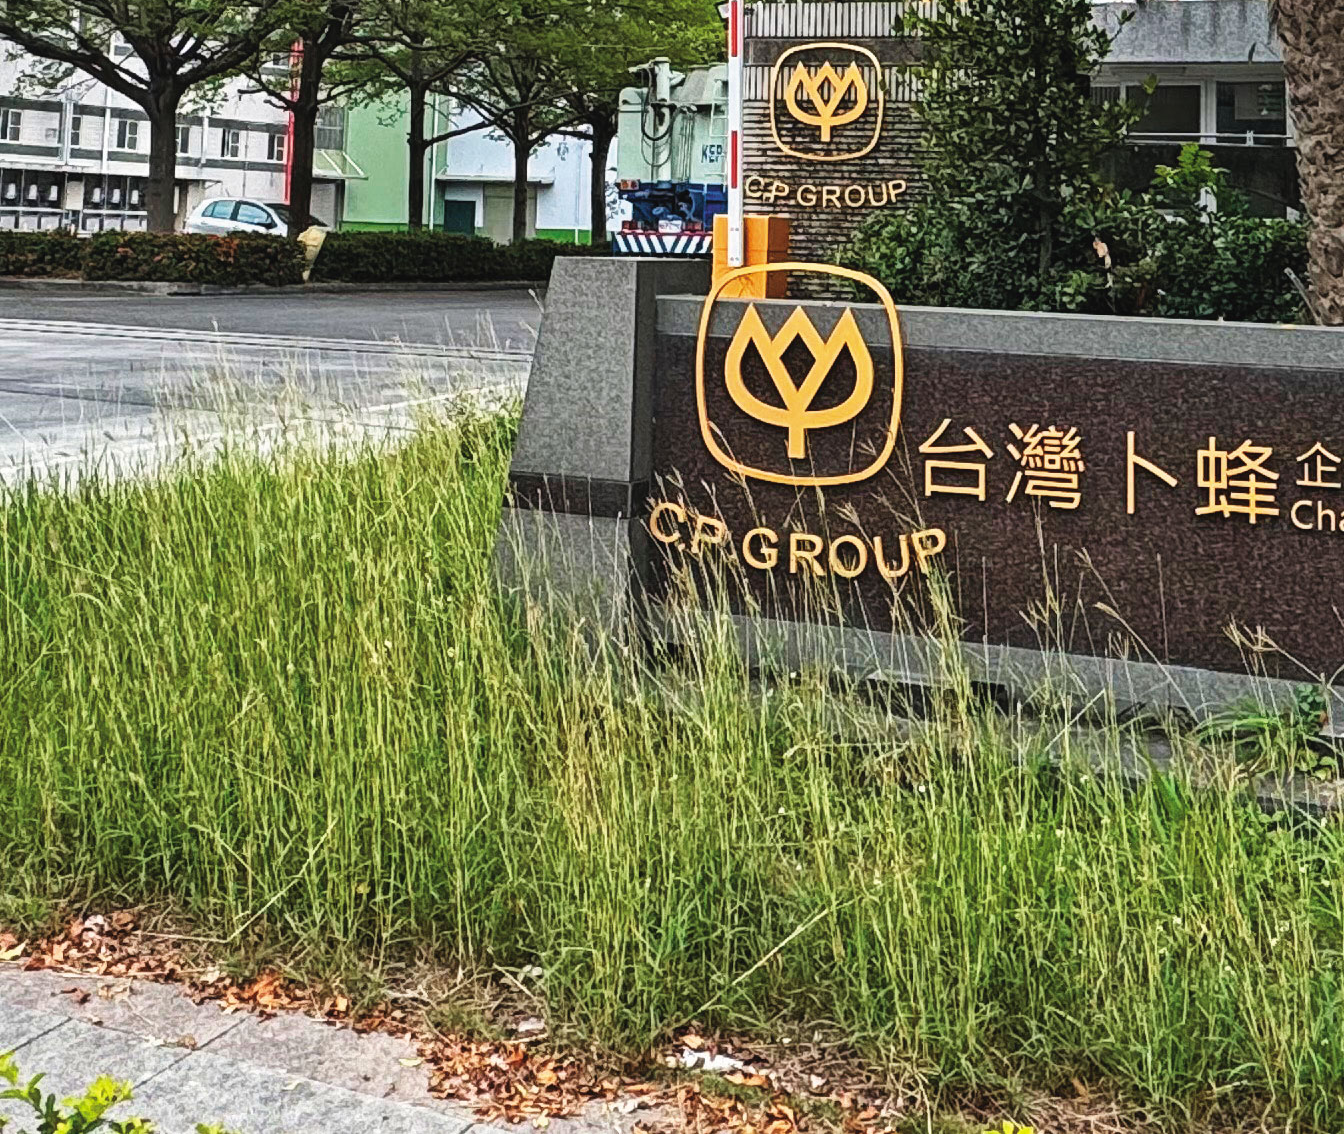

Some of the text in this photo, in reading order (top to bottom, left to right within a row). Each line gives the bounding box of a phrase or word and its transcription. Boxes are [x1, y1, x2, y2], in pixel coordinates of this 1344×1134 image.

[797, 180, 907, 208] GROUP
[918, 418, 1281, 525] 台灣卜蜂
[742, 527, 947, 579] GROUP
